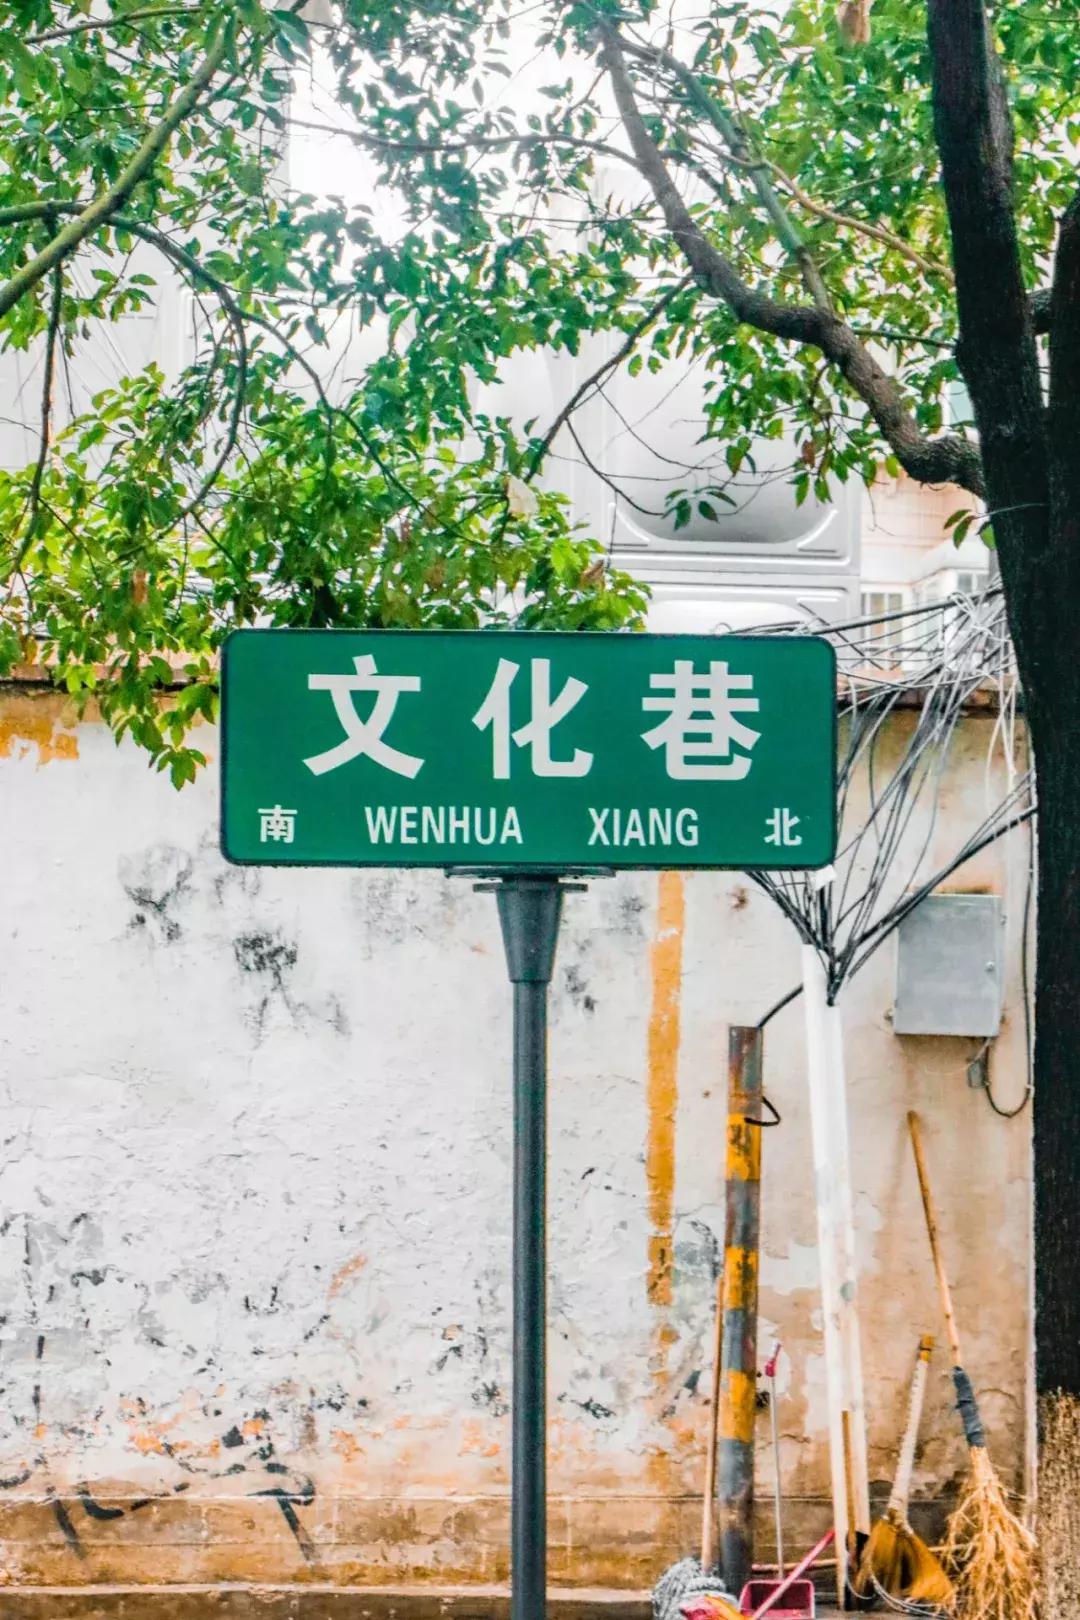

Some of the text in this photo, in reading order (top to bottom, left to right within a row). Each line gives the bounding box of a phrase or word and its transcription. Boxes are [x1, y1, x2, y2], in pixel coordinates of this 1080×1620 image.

[303, 654, 761, 781] 文化巷
[258, 804, 298, 844] 南
[365, 805, 699, 847] WENHUA XIANG
[764, 807, 803, 847] 北
